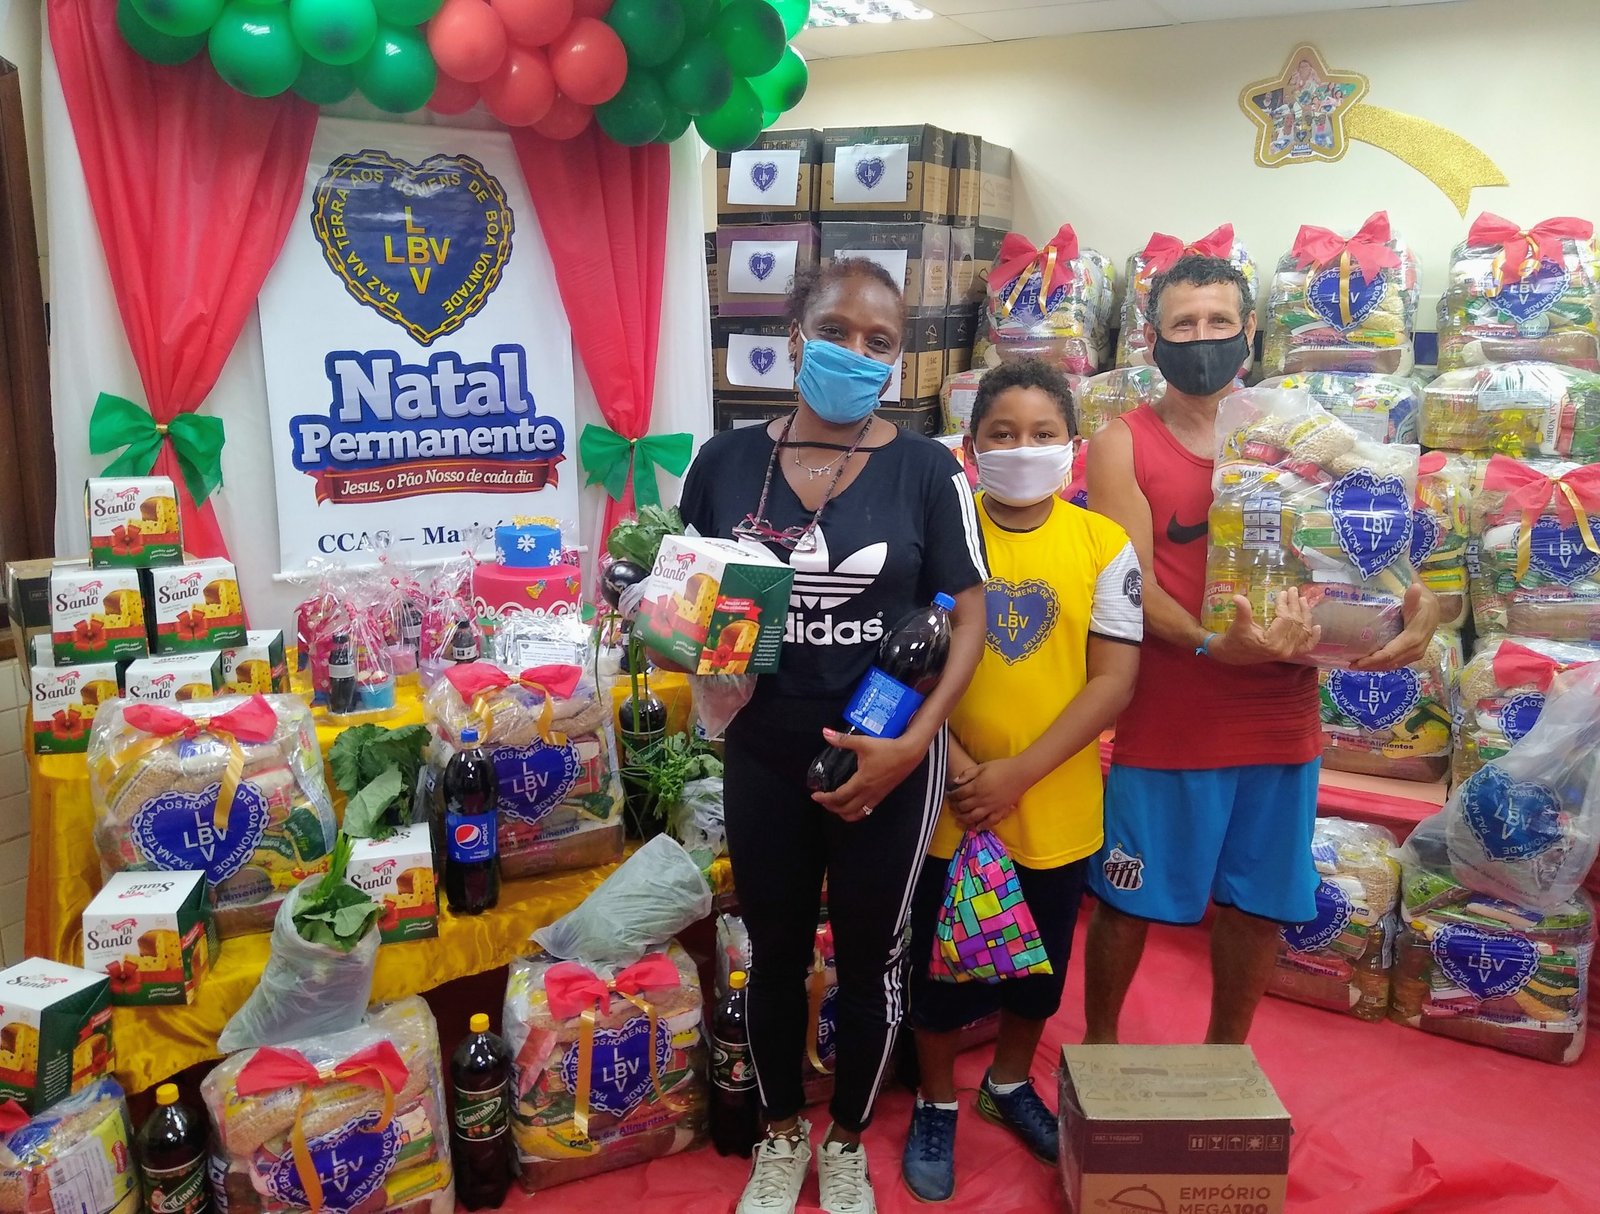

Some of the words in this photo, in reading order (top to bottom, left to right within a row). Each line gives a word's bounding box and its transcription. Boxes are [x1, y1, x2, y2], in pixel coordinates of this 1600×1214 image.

[350, 170, 384, 188] AOS
[391, 172, 461, 197] HOMENS
[468, 180, 488, 203] DE
[331, 188, 349, 249] TERRA
[485, 210, 498, 247] BOA
[384, 236, 450, 264] LBV
[347, 251, 369, 277] NA
[367, 277, 400, 304] PAZ
[442, 253, 493, 315] VONTADE
[1353, 301, 1374, 319] VONTA
[334, 352, 528, 422] Natal
[298, 418, 557, 463] Permanente
[341, 480, 385, 496] Jesus,
[386, 479, 395, 490] o
[397, 472, 423, 489] Pão
[426, 469, 464, 485] Nosso
[466, 469, 482, 483] de
[483, 471, 513, 485] cada
[514, 471, 534, 484] dia
[1350, 478, 1370, 490] AOS
[1368, 484, 1401, 496] HOMENS
[94, 499, 136, 517] Santo
[1342, 520, 1354, 537] NA
[1363, 516, 1393, 535] LBV
[317, 530, 391, 554] CCAS
[1348, 536, 1364, 554] PAZ
[1422, 531, 1432, 551] BOA
[1549, 543, 1584, 556] LBV
[1371, 535, 1407, 568] VONTADE
[654, 555, 686, 581] Santo
[158, 586, 200, 604] Santo
[986, 584, 1002, 593] AOS
[1004, 587, 1038, 598] HOMENS
[1040, 589, 1050, 599] DE
[56, 594, 99, 612] Santo
[998, 615, 1029, 629] LBV
[1024, 620, 1050, 651] VONTADE
[35, 684, 76, 701] Santo
[130, 686, 171, 700] Santo
[1339, 695, 1347, 706] NA
[1359, 690, 1391, 703] LBV
[1404, 684, 1414, 703] BOA
[1523, 700, 1544, 708] AOS
[1375, 702, 1408, 726] VONTADE
[493, 750, 514, 763] AOS
[564, 756, 573, 777] BOA
[513, 772, 549, 793] LBV
[184, 792, 219, 809] HOME
[237, 791, 254, 805] DE
[533, 779, 570, 813] VONTADE
[156, 800, 183, 813] AOS
[248, 805, 259, 829] BOA
[142, 811, 157, 850] TERRA
[183, 826, 228, 849] LBV
[157, 844, 174, 861] NA
[213, 829, 254, 875] VONTADE
[170, 854, 193, 870] PAZ
[351, 874, 392, 891] Santo
[1331, 892, 1343, 906] DE
[1332, 907, 1344, 924] BOA
[87, 930, 133, 951] Santo
[1300, 924, 1337, 946] VONTADE
[1444, 957, 1455, 970] NA
[1468, 955, 1506, 971] LBV
[1454, 968, 1470, 984] PAZ
[1485, 969, 1526, 995] VONTADE
[607, 1025, 649, 1046] HOMENS
[603, 1057, 640, 1082] LBV
[382, 1131, 392, 1158] BOA
[1179, 1183, 1271, 1200] EMPÓRIO
[1179, 1203, 1268, 1214] MEGA100
